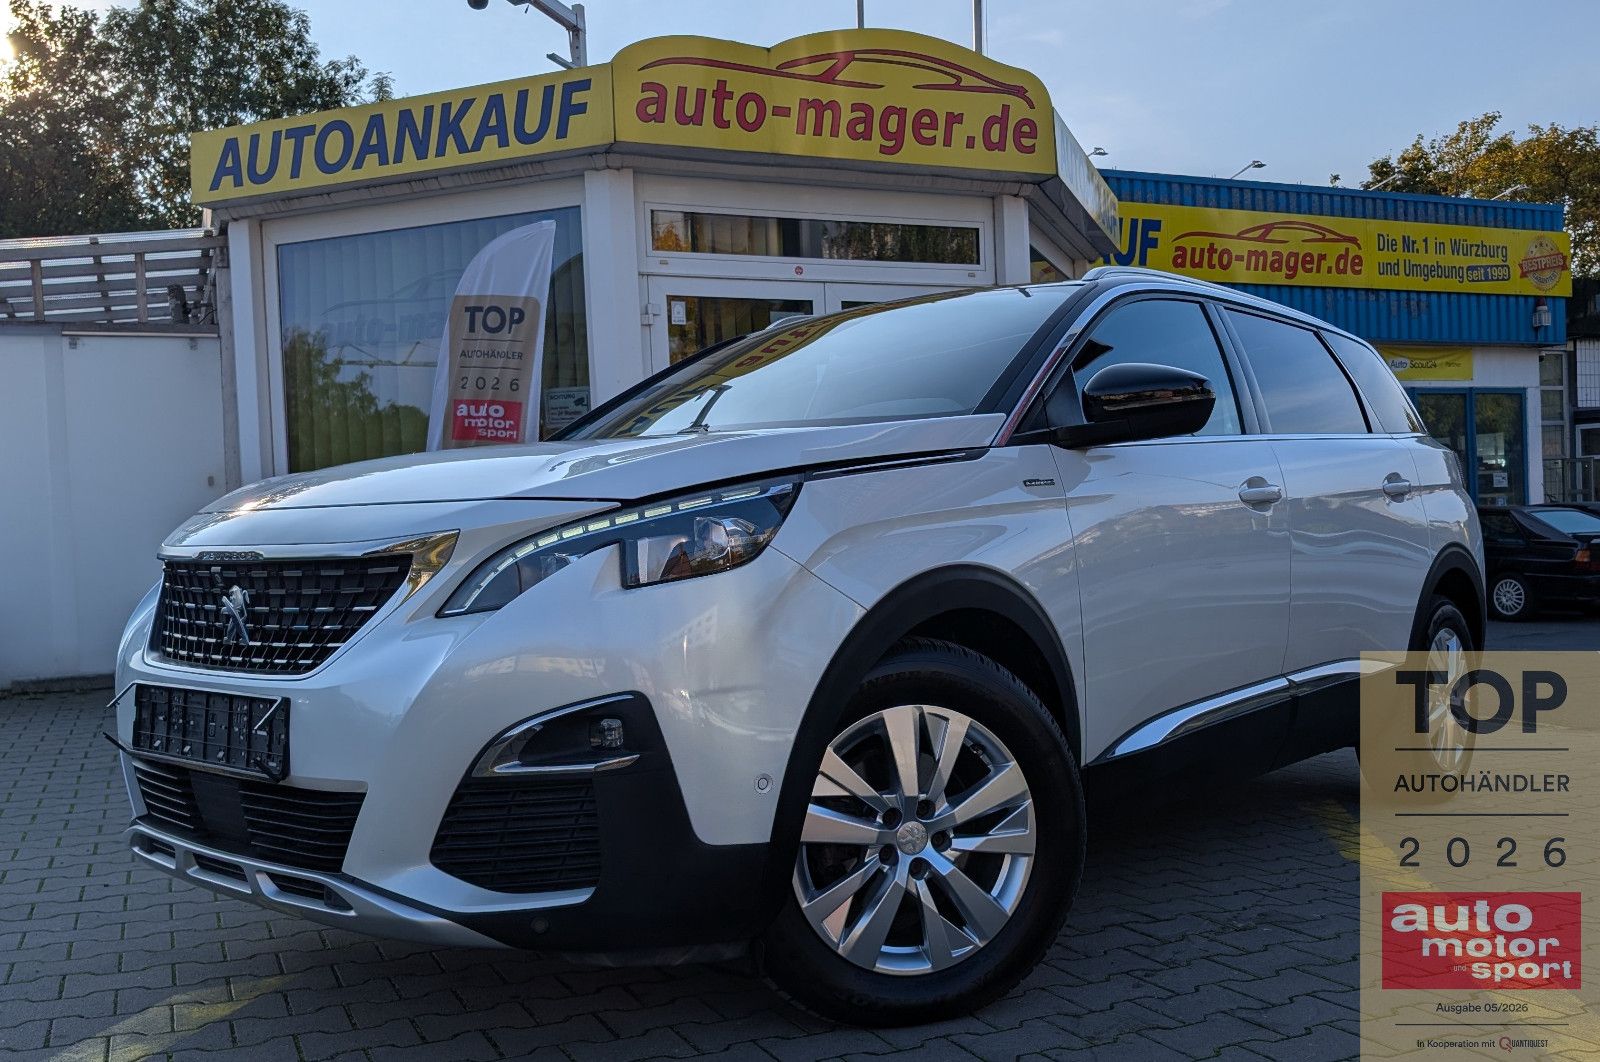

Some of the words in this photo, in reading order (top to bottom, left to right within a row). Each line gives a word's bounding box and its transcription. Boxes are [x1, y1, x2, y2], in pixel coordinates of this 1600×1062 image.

[635, 79, 1039, 156] auto-mager.de
[209, 78, 592, 191] AUTOANKAUF
[1102, 217, 1162, 267] UF
[1377, 233, 1397, 252] Die
[1434, 237, 1446, 256] in
[1450, 237, 1508, 263] Würzburg
[1171, 243, 1363, 280] auto-mager.de
[1378, 259, 1400, 276] und
[1403, 259, 1464, 284] Umgebung
[1467, 267, 1485, 281] seit
[1487, 266, 1509, 281] 1999
[464, 305, 526, 334] TOP
[456, 402, 505, 417] auto
[464, 418, 515, 429] motor
